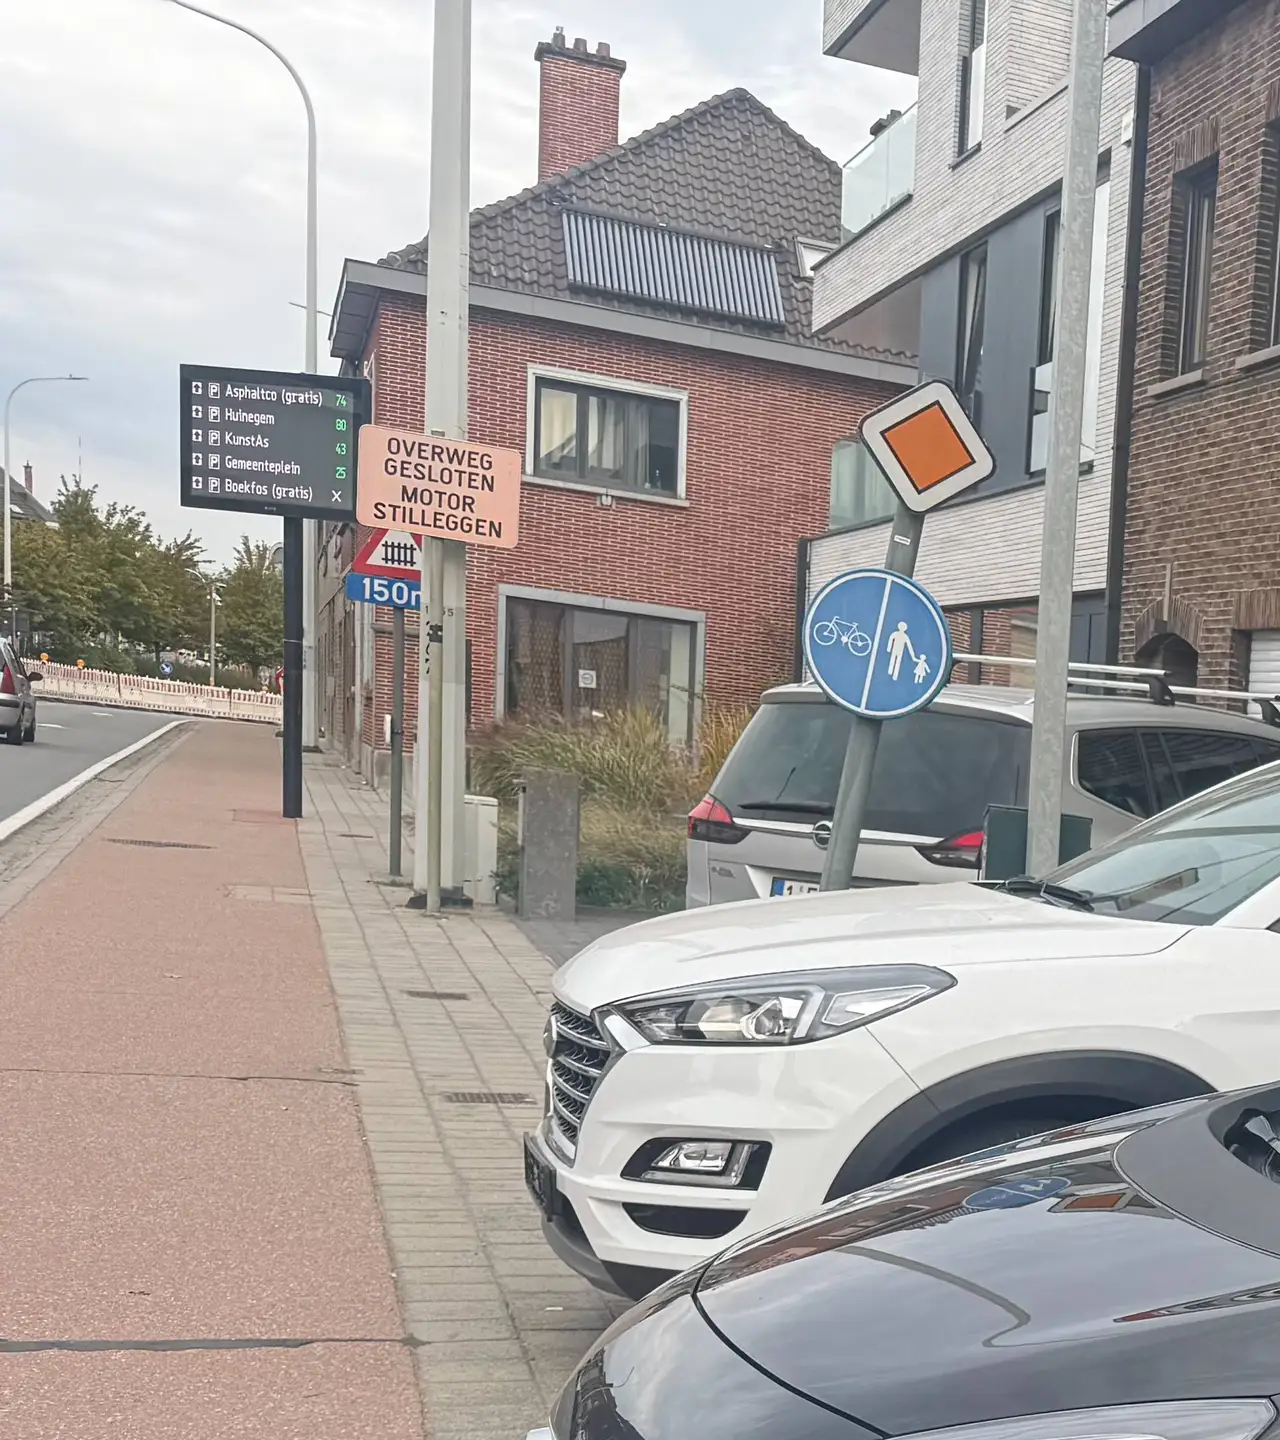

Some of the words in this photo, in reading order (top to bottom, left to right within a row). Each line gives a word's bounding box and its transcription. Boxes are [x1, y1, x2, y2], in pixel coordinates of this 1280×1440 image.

[225, 384, 277, 401] Asphaltco
[281, 389, 323, 407] (gratis)
[335, 394, 347, 407] 74
[225, 408, 275, 425] Huinegem
[335, 419, 347, 431] 80
[225, 432, 270, 448] KunstAs
[335, 443, 347, 455] 43
[387, 437, 493, 471] OVERWEG
[225, 455, 301, 475] Gemeenteplein
[335, 467, 346, 479] 25
[384, 458, 494, 492] GESLOTEN
[225, 479, 268, 495] Boekfos
[272, 484, 313, 502] (gratis)
[401, 485, 476, 514] MOTOR
[373, 502, 502, 539] STILLEGGEN
